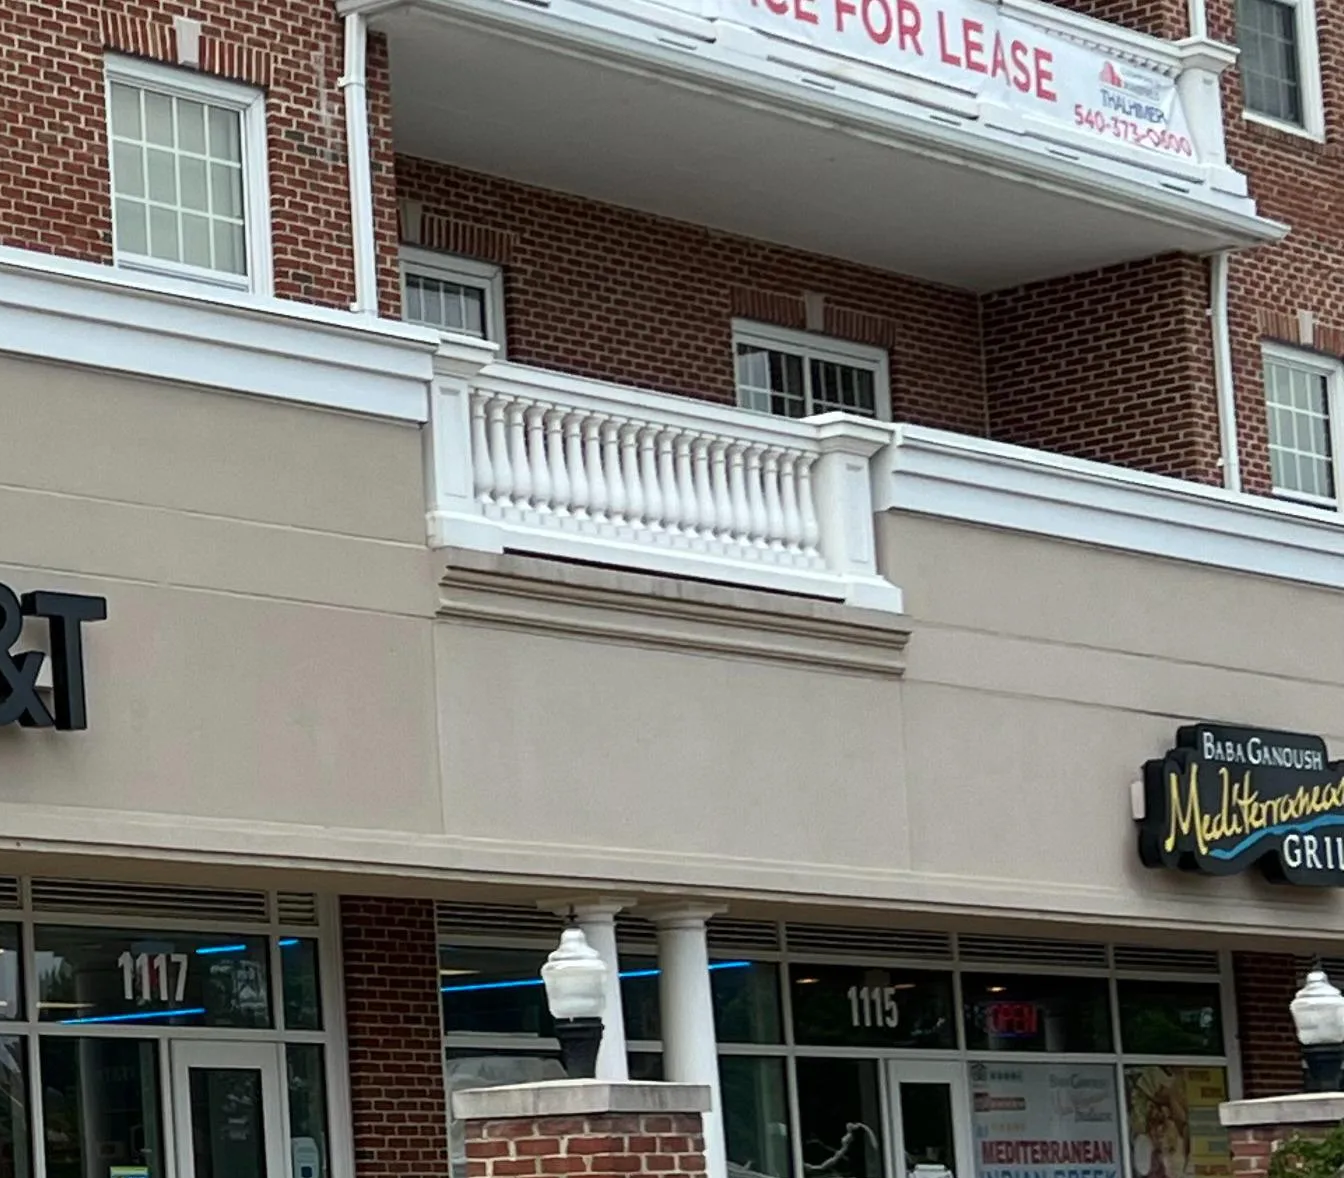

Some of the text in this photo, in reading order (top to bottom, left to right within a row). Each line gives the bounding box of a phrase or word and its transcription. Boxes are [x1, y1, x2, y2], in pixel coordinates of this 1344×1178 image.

[835, 0, 923, 55] FOR
[937, 11, 1057, 101] LEASE
[118, 951, 188, 1001] 1117
[847, 986, 899, 1028] 1115
[981, 1140, 1116, 1165] MEDITERRANEAN
